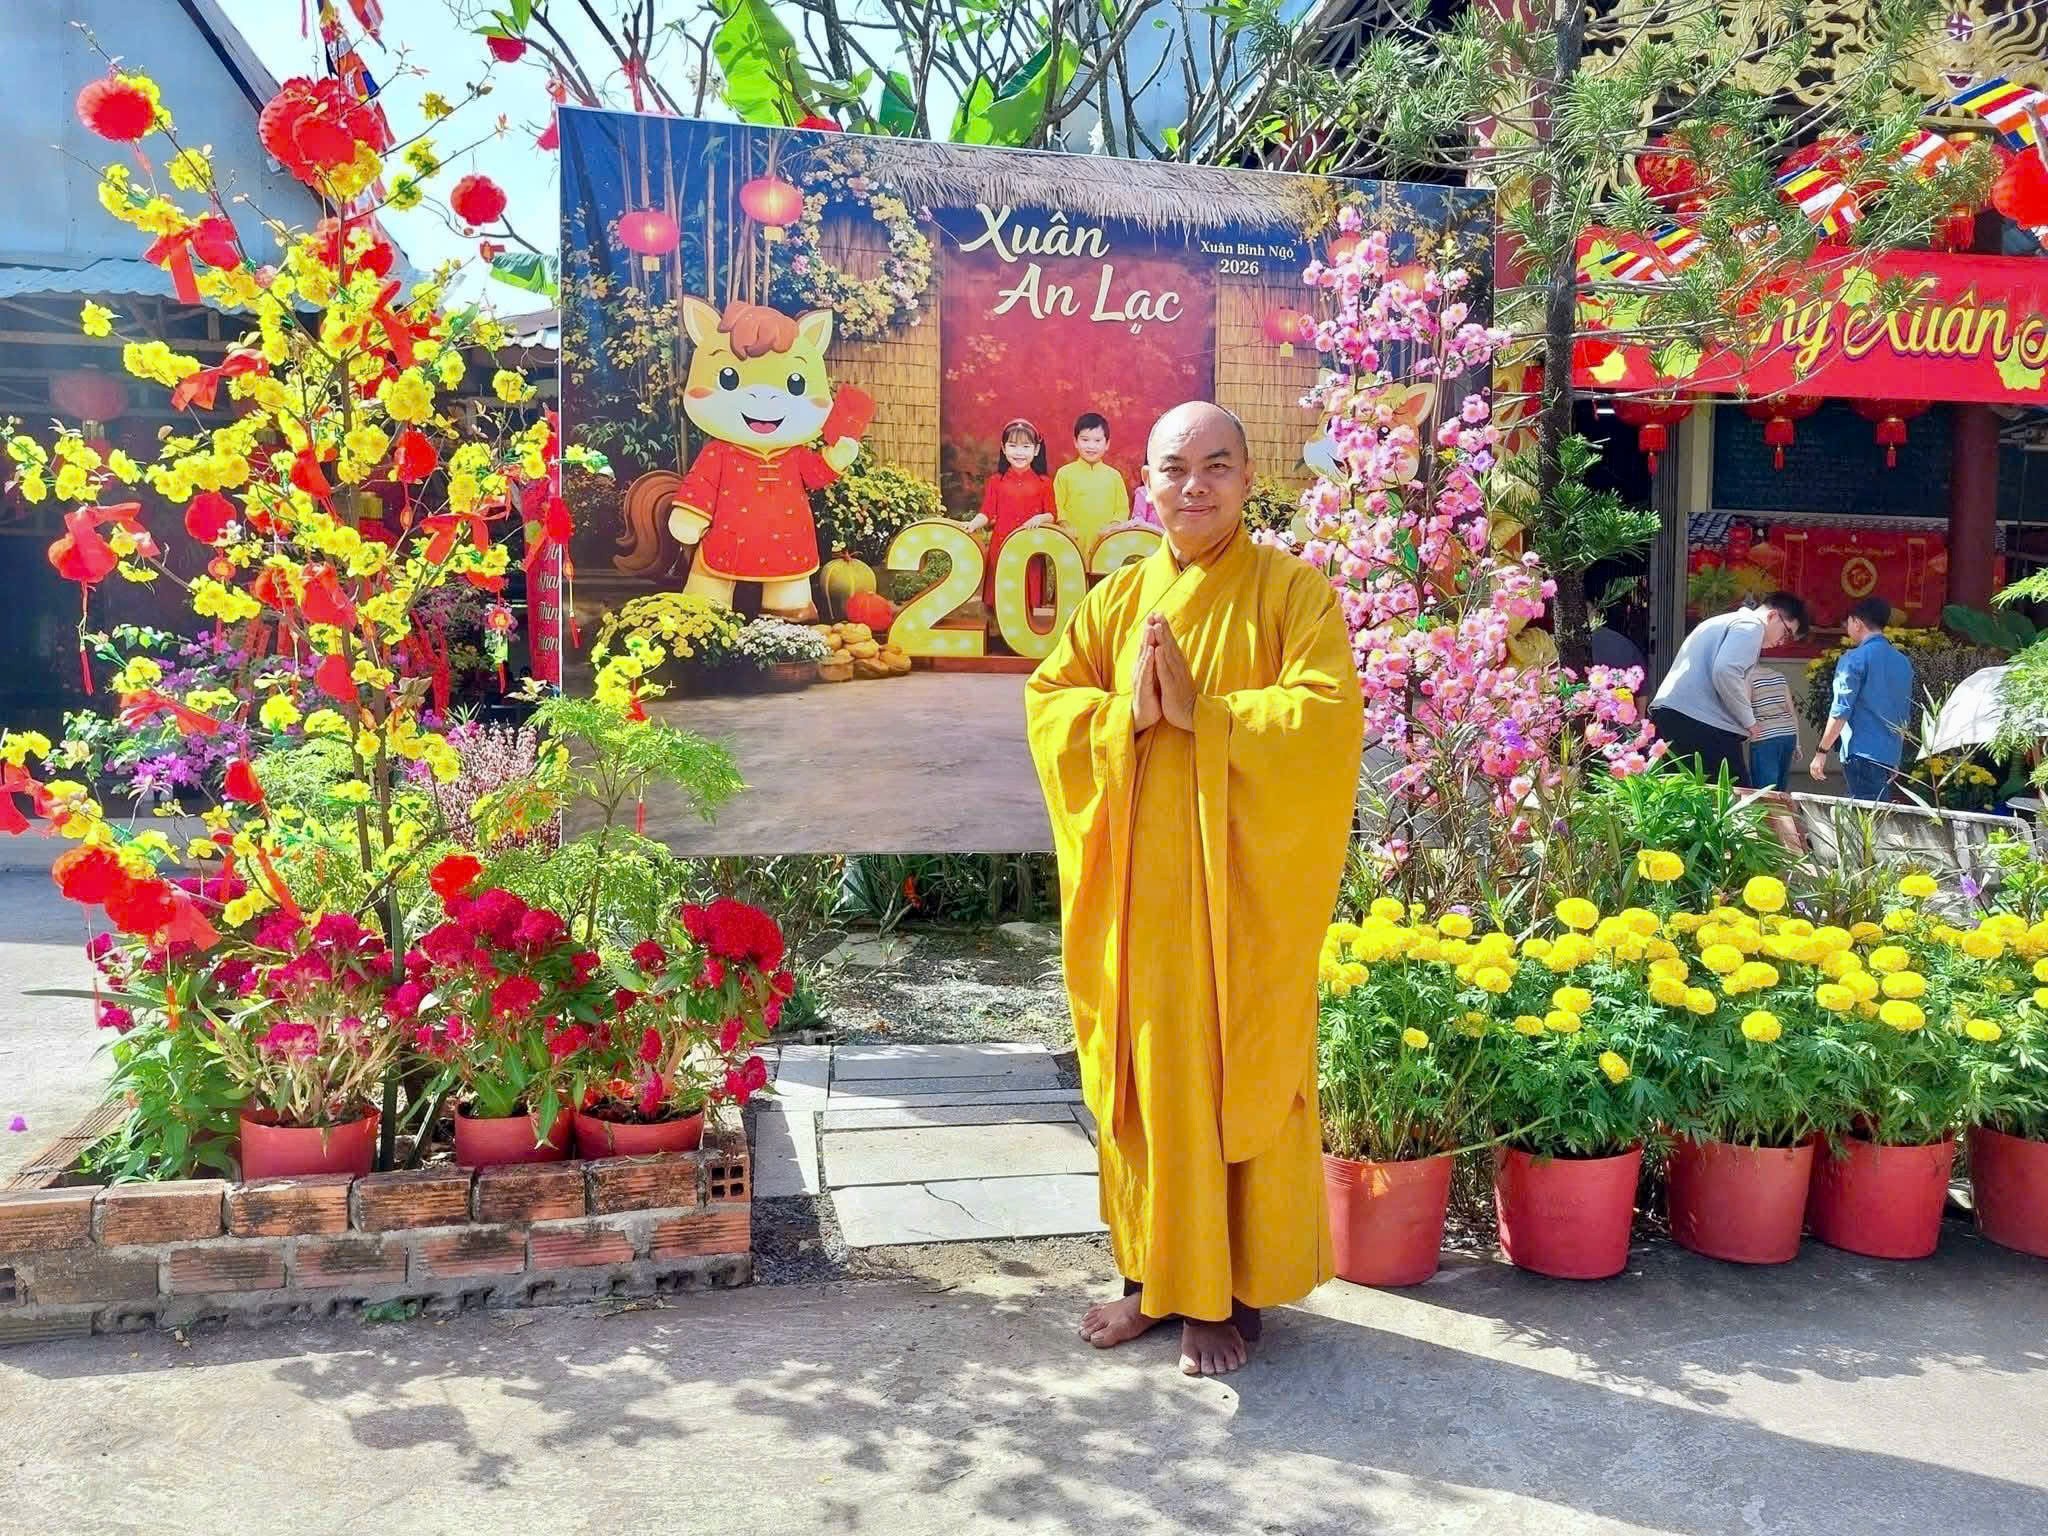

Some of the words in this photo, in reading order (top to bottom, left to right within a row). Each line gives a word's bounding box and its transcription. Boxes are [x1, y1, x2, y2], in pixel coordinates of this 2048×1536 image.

[959, 202, 1111, 263] Xuân
[1200, 240, 1233, 253] Xuân
[1219, 258, 1260, 276] 2026
[993, 262, 1081, 320] An
[1090, 263, 1185, 335] Lạc
[1845, 278, 2013, 357] Xuân
